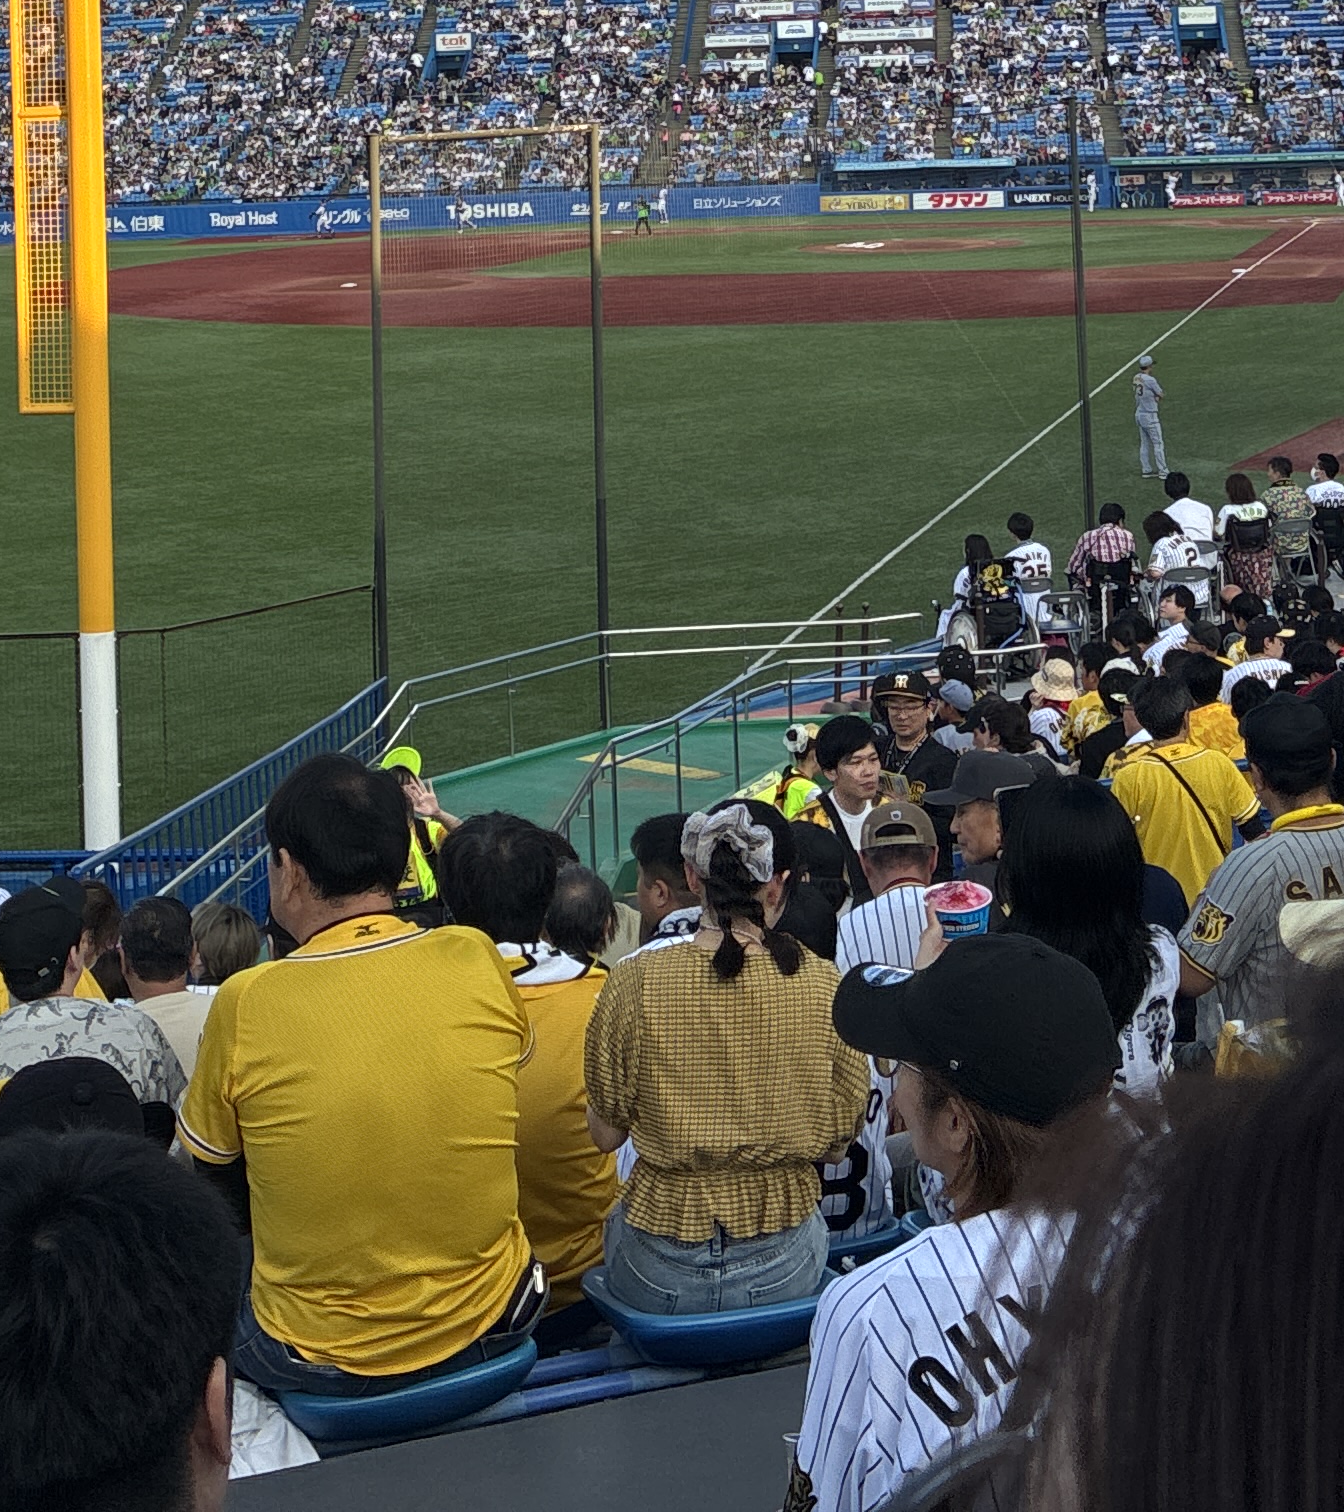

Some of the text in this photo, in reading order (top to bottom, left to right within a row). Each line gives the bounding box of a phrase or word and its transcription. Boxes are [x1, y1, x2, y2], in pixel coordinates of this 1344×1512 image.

[693, 194, 783, 210] 日立ソリューションズ
[928, 193, 989, 208] タフマン
[209, 209, 279, 229] Royal Host
[1185, 546, 1200, 568] 2
